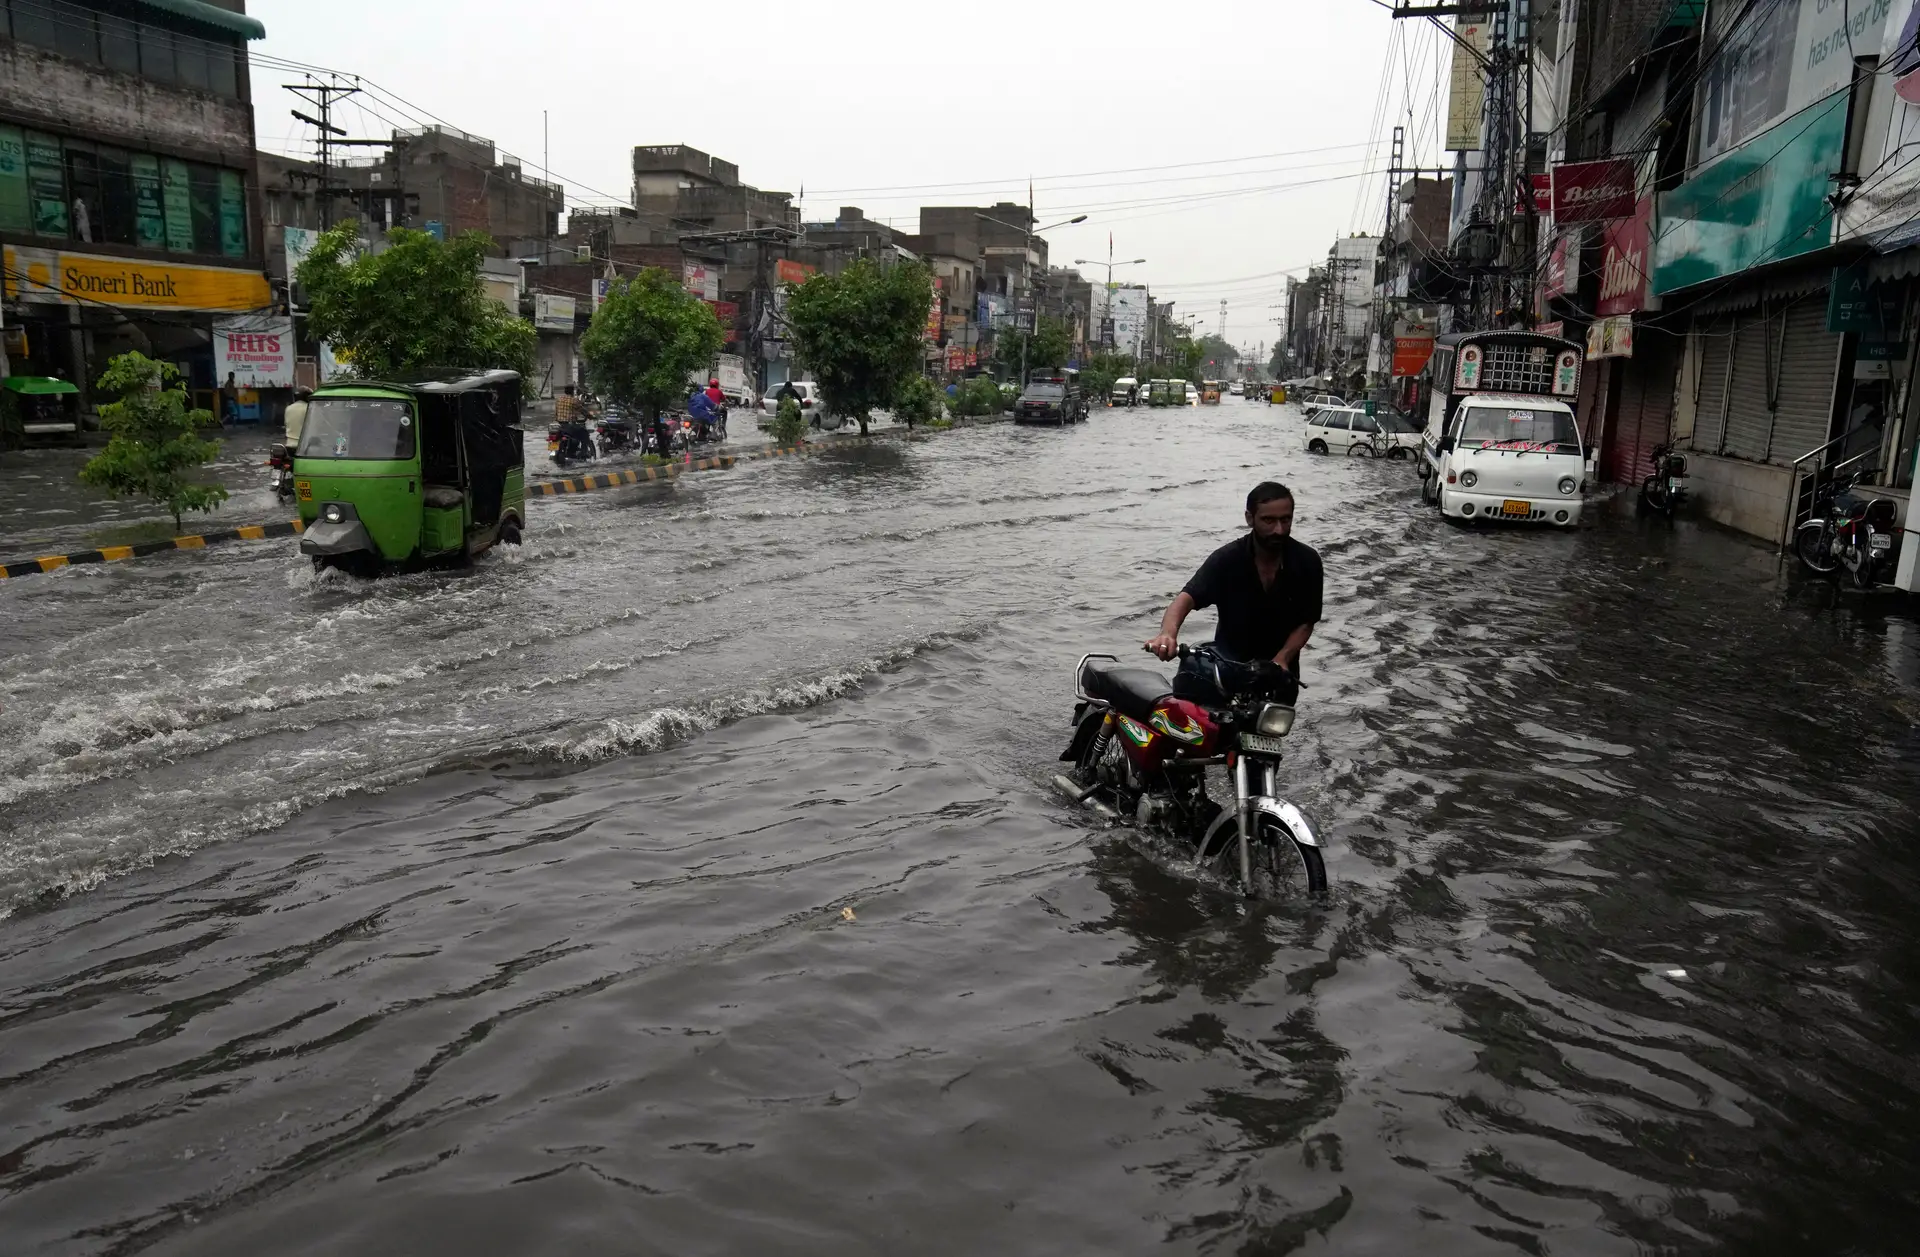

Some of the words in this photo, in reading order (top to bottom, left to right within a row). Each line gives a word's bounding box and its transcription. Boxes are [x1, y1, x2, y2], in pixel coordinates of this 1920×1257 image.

[1808, 36, 1829, 70] has
[1831, 5, 1870, 54] never
[1562, 185, 1628, 203] Bata
[66, 268, 126, 295] Soneri
[132, 274, 177, 297] Bank
[1600, 239, 1642, 301] Bata
[228, 334, 280, 352] IELTS
